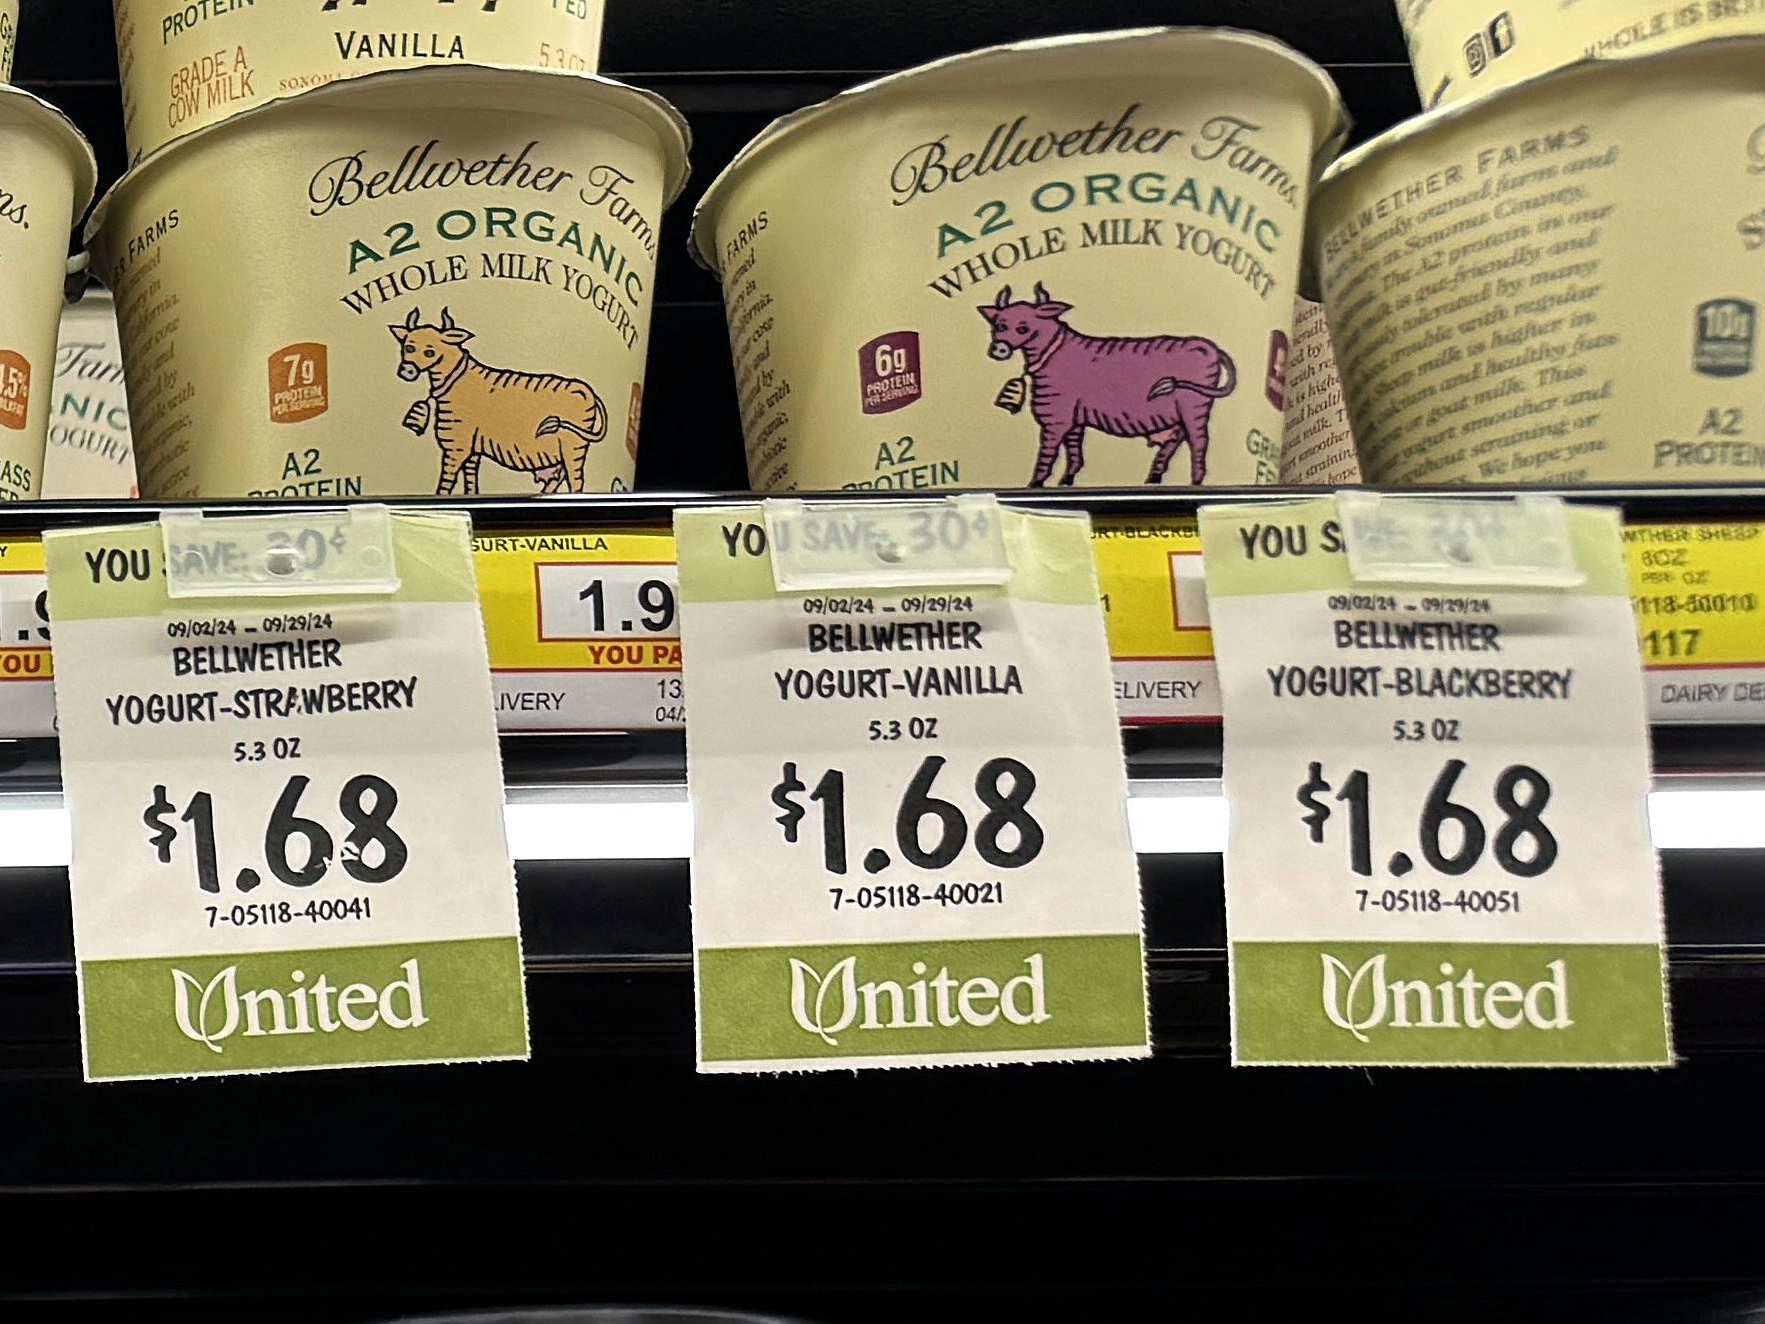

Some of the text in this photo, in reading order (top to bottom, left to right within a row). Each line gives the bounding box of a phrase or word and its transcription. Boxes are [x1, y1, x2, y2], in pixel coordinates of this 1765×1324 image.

[335, 32, 464, 60] VANILLA
[809, 621, 982, 654] BELLWETHER
[1334, 621, 1501, 652] BELLWETHER
[173, 639, 341, 675] BELLWETHER
[775, 667, 1022, 699] YOGURT-VANILLA
[1269, 667, 1574, 699] YOGURT-BLACKBERRY
[106, 678, 417, 726] YOGURT-STRAWBERRY
[771, 756, 1044, 875] $1.68
[1297, 760, 1558, 877] $1.68
[143, 774, 408, 895] $1.68
[205, 898, 371, 927] 7-05118-40041
[830, 884, 1002, 909] 7-05118-40021
[1356, 890, 1521, 913] 7-05118-40051
[174, 960, 428, 1053] United
[790, 955, 1050, 1046] United
[1321, 953, 1574, 1042] United
